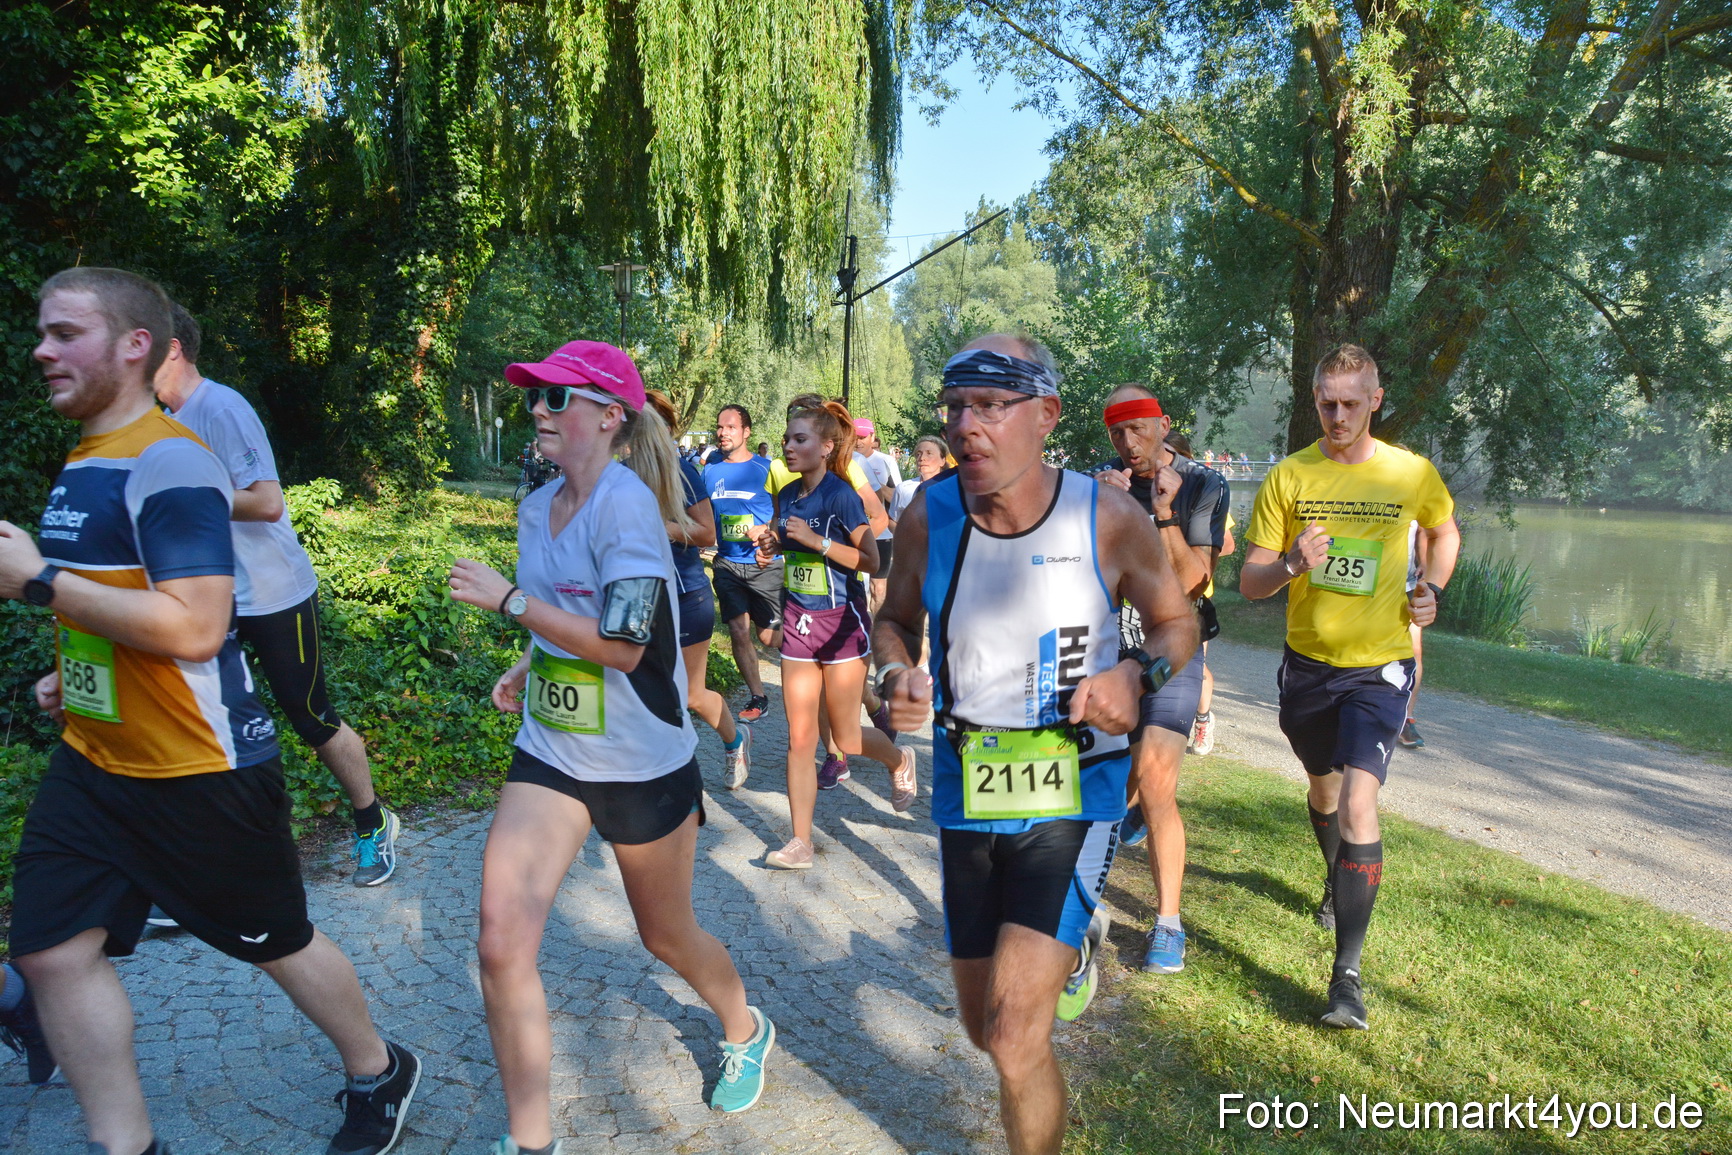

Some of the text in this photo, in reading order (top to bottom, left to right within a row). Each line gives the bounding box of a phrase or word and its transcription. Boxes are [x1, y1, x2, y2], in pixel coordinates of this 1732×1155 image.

[1329, 516, 1370, 524] KOMPETENZ
[793, 566, 813, 583] 497
[1324, 556, 1365, 578] 735
[1341, 577, 1362, 585] Markus
[63, 657, 97, 695] 568
[1024, 661, 1035, 695] WASTE
[537, 675, 579, 712] 760
[976, 762, 1064, 793] 2114
[1094, 822, 1121, 893] HUBER
